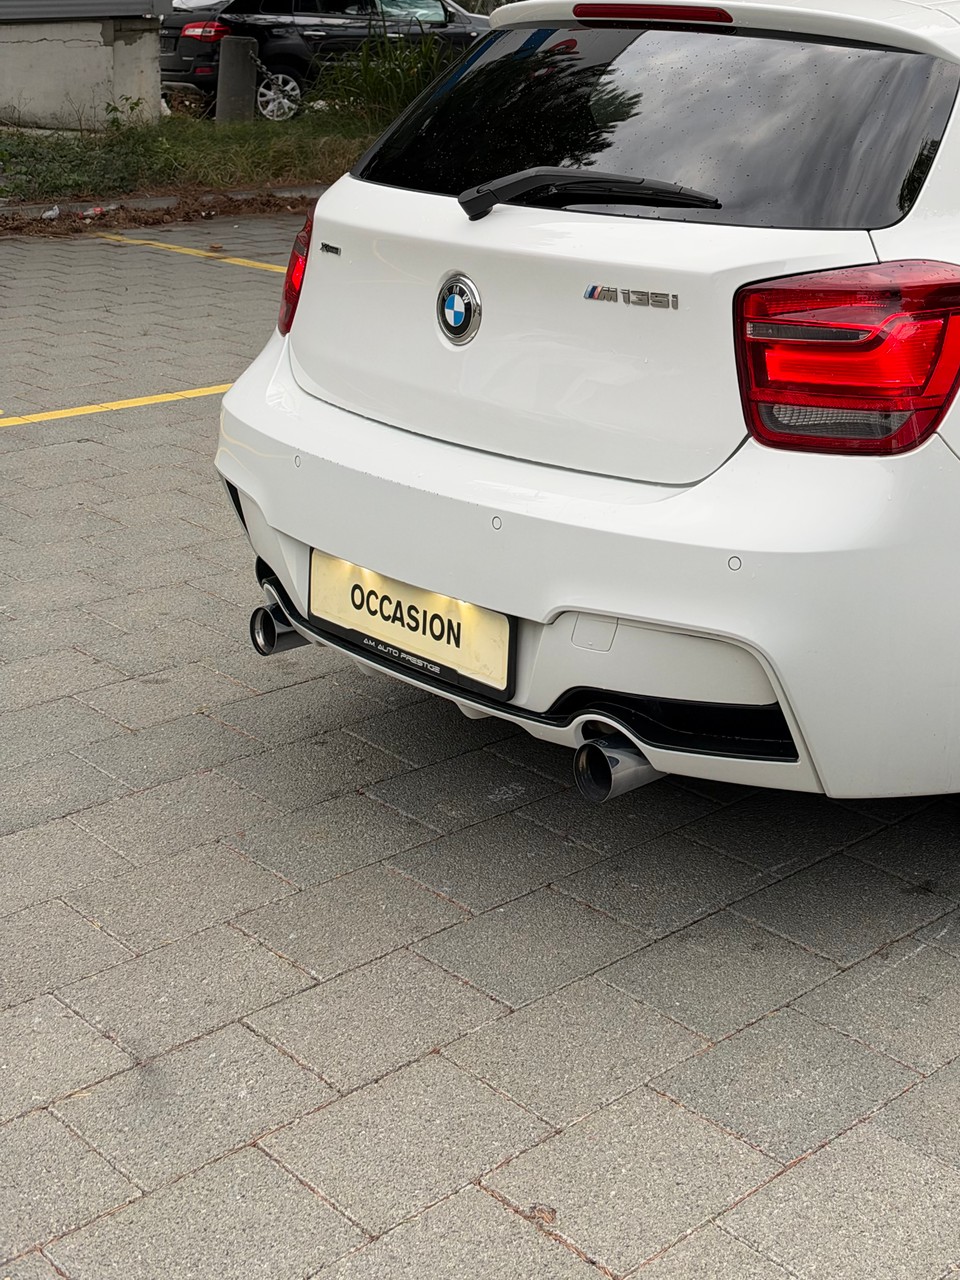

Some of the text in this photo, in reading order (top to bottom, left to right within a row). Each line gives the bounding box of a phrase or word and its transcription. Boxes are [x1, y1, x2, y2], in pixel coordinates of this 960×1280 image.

[350, 583, 462, 649] OCCASION
[377, 644, 399, 657] AUTO
[400, 652, 441, 674] PRESTIGE
